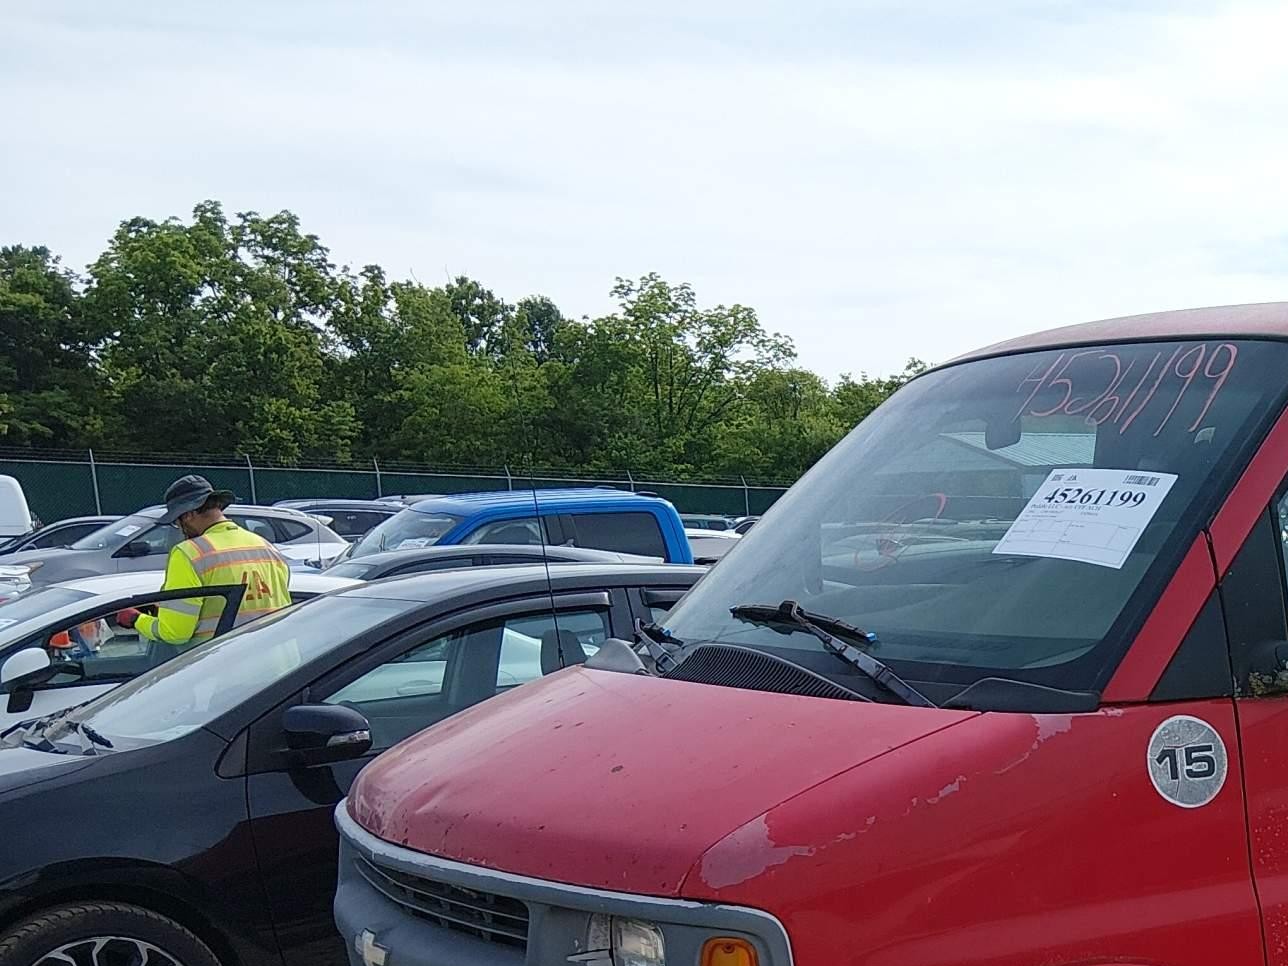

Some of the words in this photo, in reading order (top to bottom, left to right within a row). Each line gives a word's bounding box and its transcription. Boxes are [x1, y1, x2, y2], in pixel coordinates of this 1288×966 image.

[1016, 344, 1238, 437] 45261199
[1043, 487, 1147, 509] 45261199
[1155, 743, 1217, 780] 15
